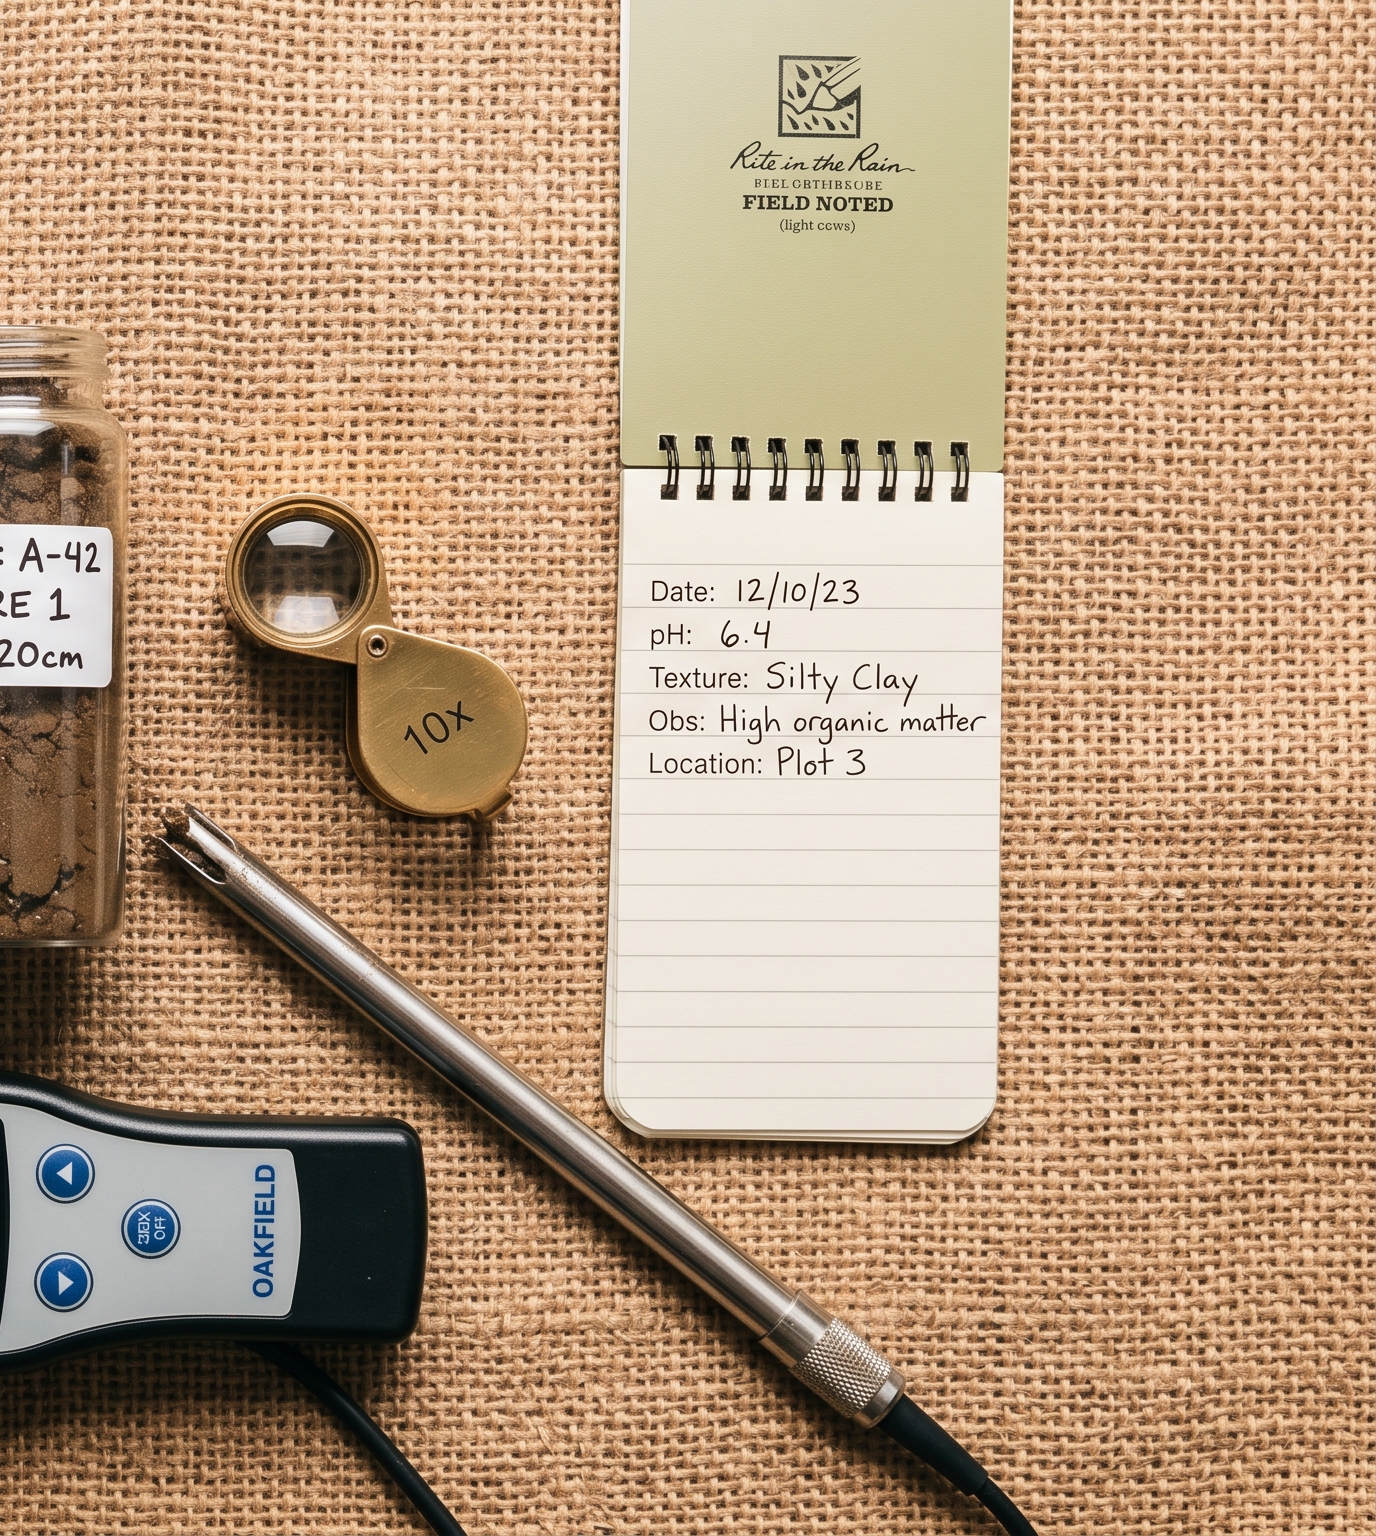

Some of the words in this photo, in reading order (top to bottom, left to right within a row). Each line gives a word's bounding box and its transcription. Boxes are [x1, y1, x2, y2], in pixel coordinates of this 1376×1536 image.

[730, 141, 782, 170] Rite
[781, 155, 809, 170] in
[812, 154, 844, 171] the
[848, 143, 915, 172] Rain
[743, 195, 810, 210] FIELD
[816, 196, 893, 212] NOTED
[779, 218, 814, 234] (light
[19, 538, 100, 573] A-42
[50, 588, 70, 621] 1
[652, 581, 714, 602] Date:
[739, 572, 859, 611] 12/10/23
[652, 624, 691, 650] pH:
[721, 620, 770, 649] 6.4
[649, 667, 747, 688] Texture:
[767, 662, 838, 704] Silty
[853, 663, 918, 707] Clay
[404, 701, 474, 754] 10x
[649, 710, 704, 731] Obs:
[721, 704, 780, 744] High
[794, 711, 888, 745] organic
[901, 704, 986, 731] matter
[650, 753, 761, 774] Location:
[778, 747, 834, 775] Plot
[846, 749, 865, 775] 3
[253, 1165, 275, 1297] OAKFIELD
